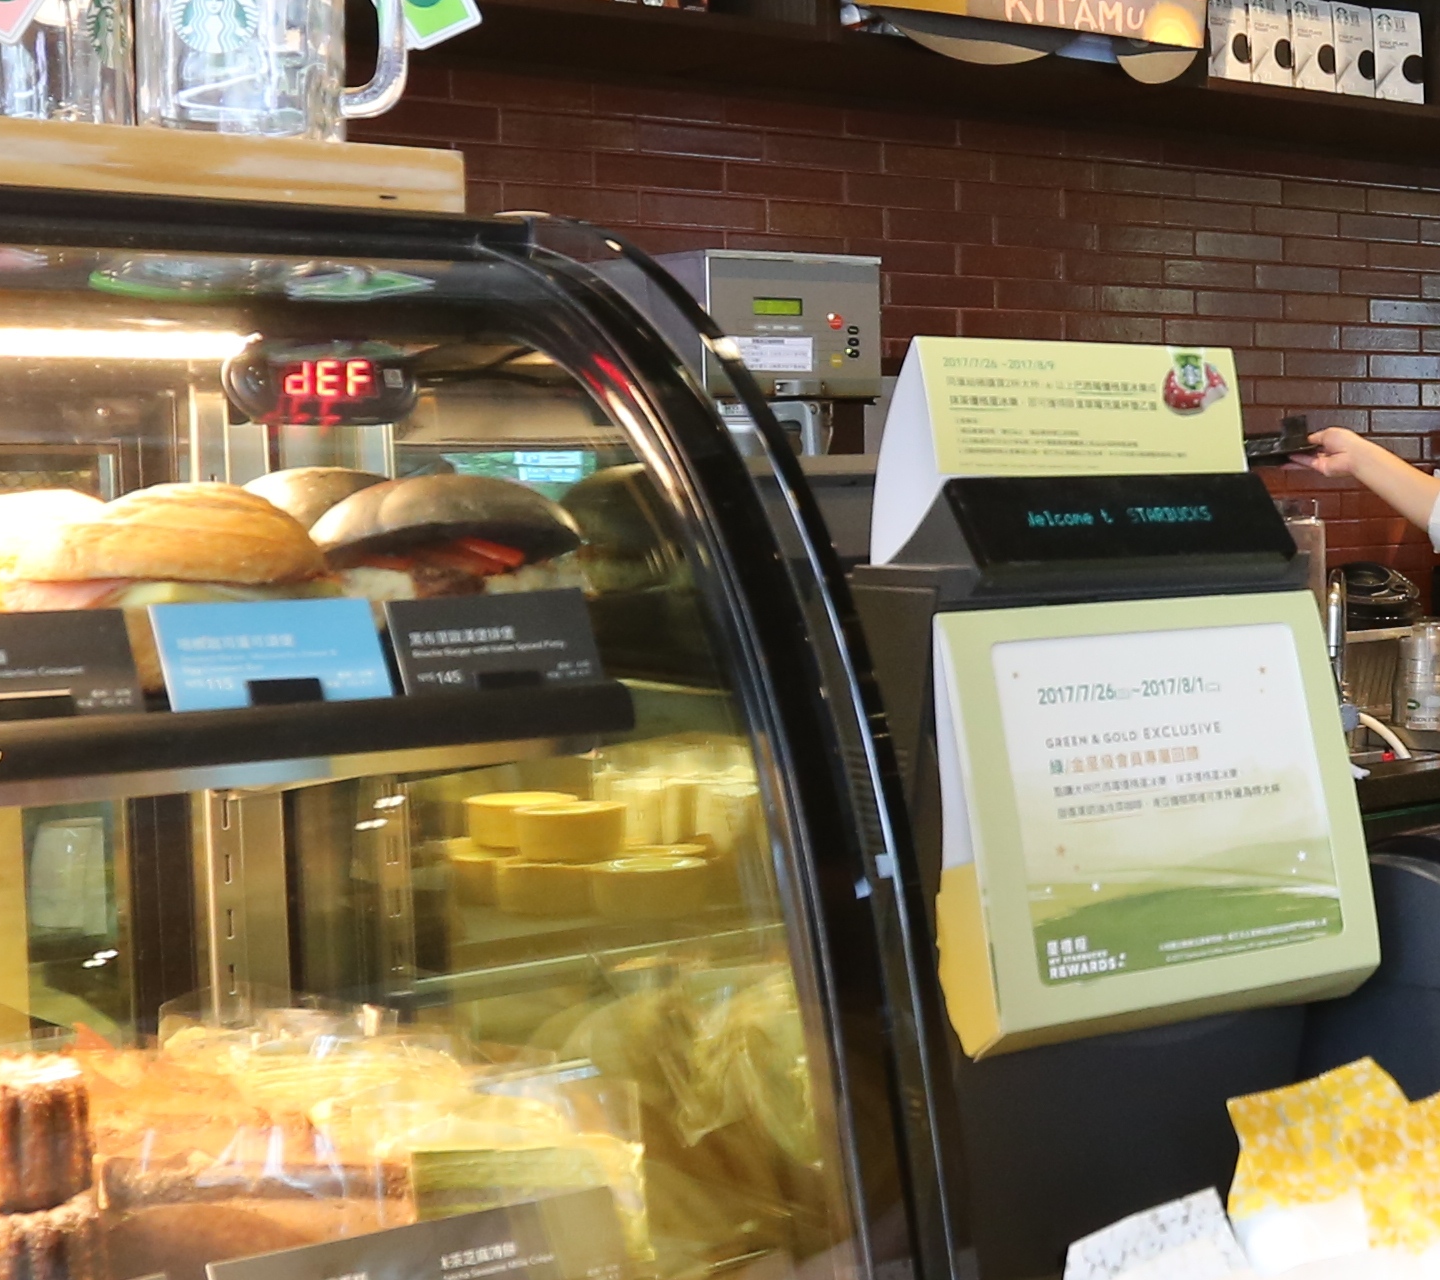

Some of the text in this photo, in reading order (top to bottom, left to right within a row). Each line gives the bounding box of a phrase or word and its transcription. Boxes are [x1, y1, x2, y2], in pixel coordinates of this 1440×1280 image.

[284, 359, 372, 397] dEF
[1126, 505, 1213, 524] STARBUCKS
[1044, 720, 1223, 750] GREEN & GOLD EXCLUSIVE
[1048, 955, 1118, 980] REWARDS
